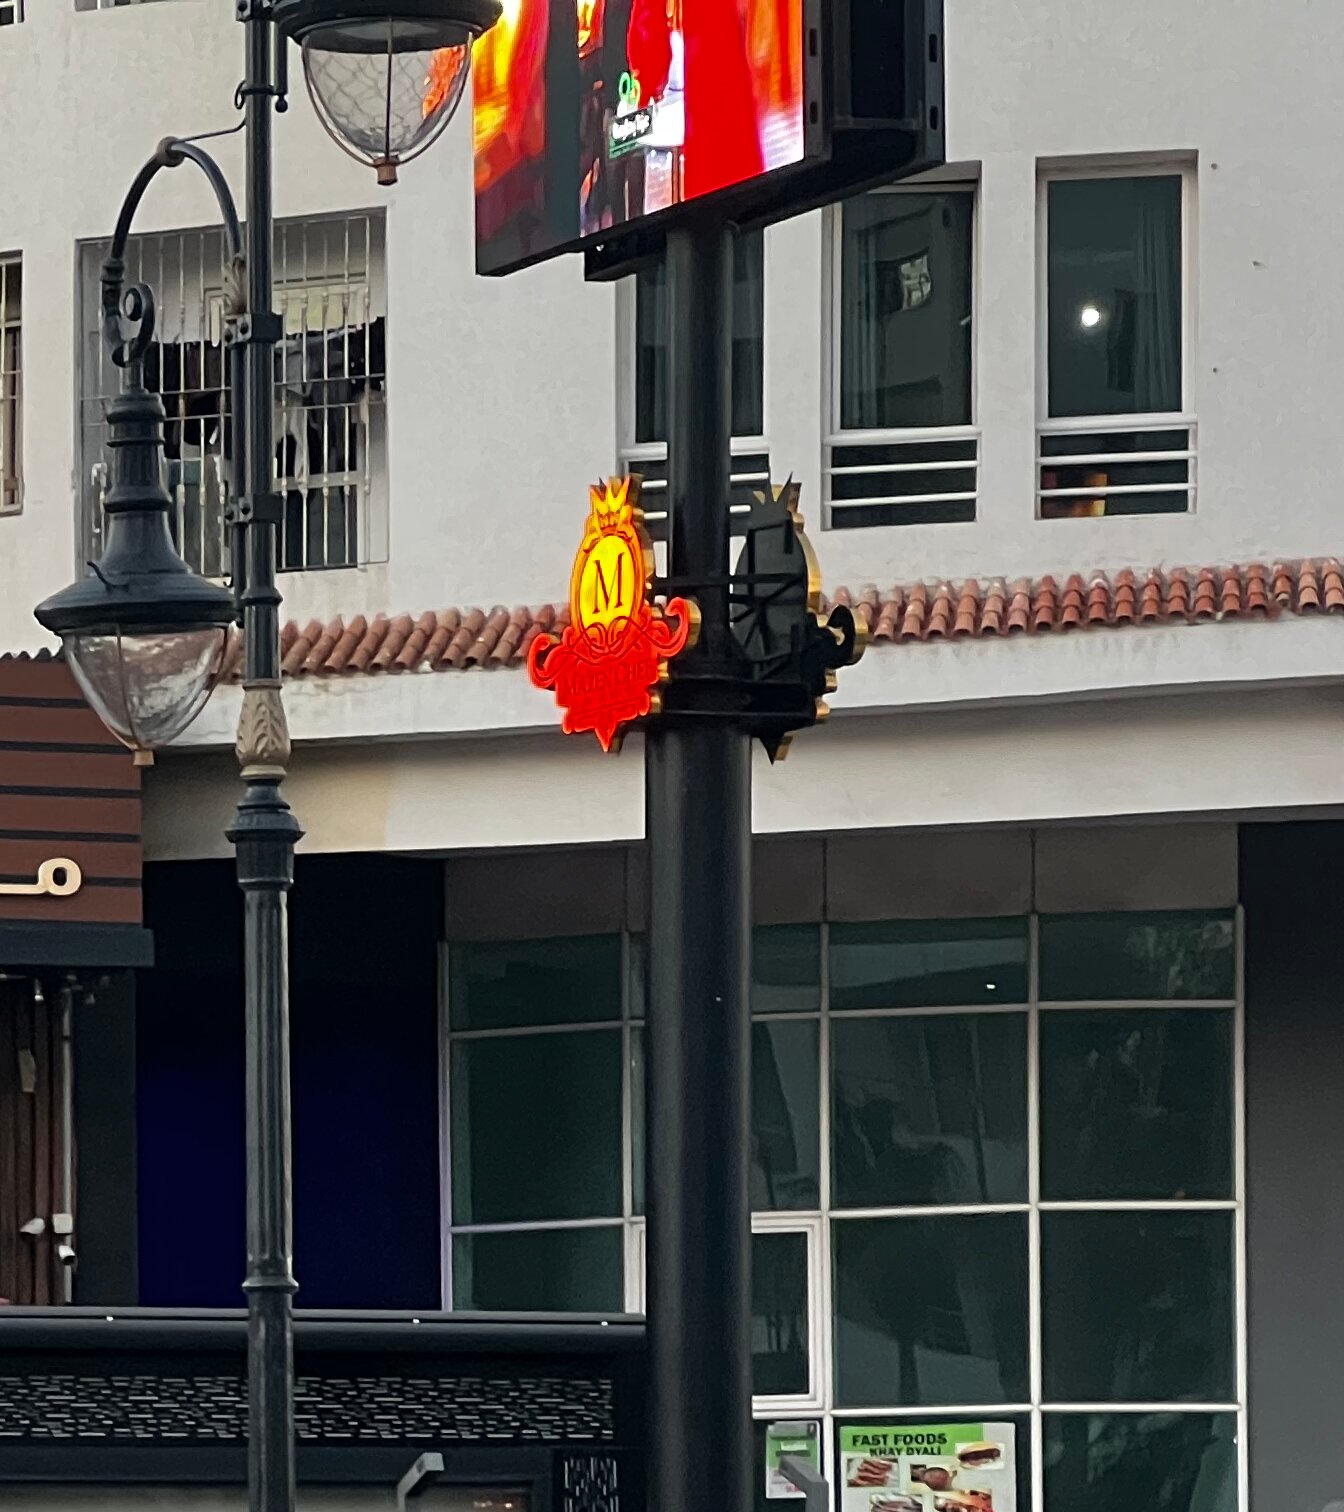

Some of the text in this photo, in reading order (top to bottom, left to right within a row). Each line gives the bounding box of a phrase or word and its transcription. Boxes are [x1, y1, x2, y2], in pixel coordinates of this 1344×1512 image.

[592, 552, 625, 614] M
[852, 1432, 948, 1447] FAST FOODS
